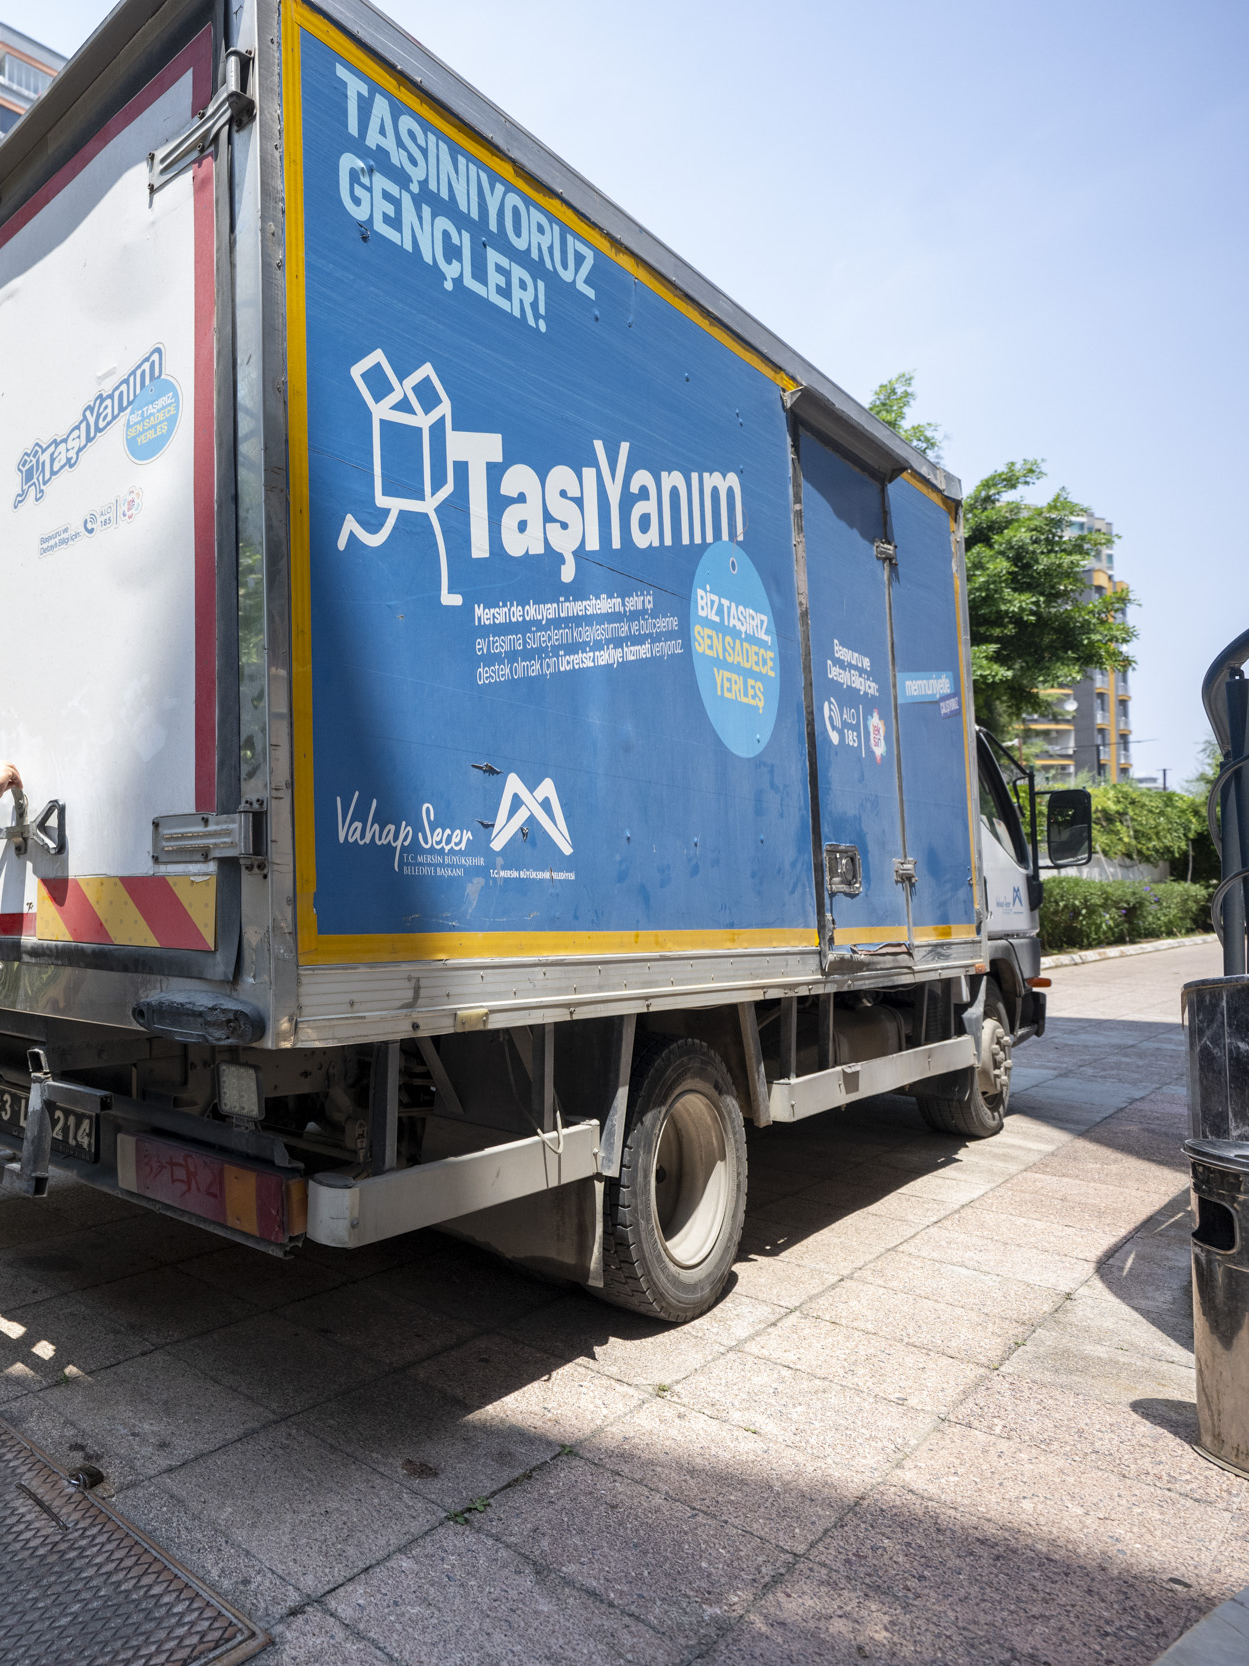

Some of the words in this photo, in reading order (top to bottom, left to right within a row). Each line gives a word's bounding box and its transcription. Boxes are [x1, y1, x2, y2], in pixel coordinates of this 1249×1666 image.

[335, 62, 596, 301] TAŞINIYORUZ
[338, 152, 547, 333] GENÇLER!
[127, 422, 143, 439] SEN
[143, 402, 177, 429] SADECE
[129, 409, 142, 425] BİZ
[137, 421, 168, 446] YERLEŞ
[100, 506, 112, 518] ALO
[100, 516, 112, 528] 185
[450, 430, 744, 583] TaşıYanım
[475, 601, 523, 626] Mersin'de
[524, 600, 558, 625] okuyan
[559, 592, 624, 618] üniversitelilerin,
[624, 590, 643, 616] şehir
[644, 590, 654, 614] içi
[696, 584, 720, 623] BİZ
[720, 597, 771, 646] TAŞIRIZ,
[475, 637, 488, 655] ev
[489, 633, 523, 657] taşıma
[526, 623, 572, 651] süreçlerini
[573, 618, 630, 646] kolaylaştırmak
[630, 621, 640, 635] ve
[640, 613, 679, 637] bütçelerine
[694, 624, 724, 660] SEN
[724, 635, 776, 678] SADECE
[476, 662, 511, 685] destek
[512, 657, 542, 679] olmak
[542, 653, 558, 679] için
[559, 647, 594, 672] ücretsiz
[594, 643, 623, 668] nakliye
[623, 639, 651, 663] hizmeti
[651, 637, 684, 660] veriyoruz.
[833, 638, 862, 666] Başvuru
[862, 655, 871, 671] ve
[713, 667, 765, 714] YERLEŞ
[827, 659, 851, 689] Detaylı
[851, 669, 865, 695] Bilgi
[905, 673, 951, 699] memnuniyetle
[842, 706, 857, 725] ALO
[844, 728, 858, 748] 185
[336, 790, 413, 873] Vahap
[418, 803, 473, 853] Seçer
[402, 853, 416, 864] T.C.
[417, 853, 443, 865] MERSİN
[444, 854, 485, 867] BÜYÜKŞEHİR
[403, 864, 436, 876] BELEDİYE
[436, 867, 464, 878] BAŞKANI
[489, 869, 499, 878] T.C.
[500, 868, 519, 879] MERSİN
[520, 868, 550, 881] BÜYÜKŞEHİR
[52, 1109, 91, 1151] 214
